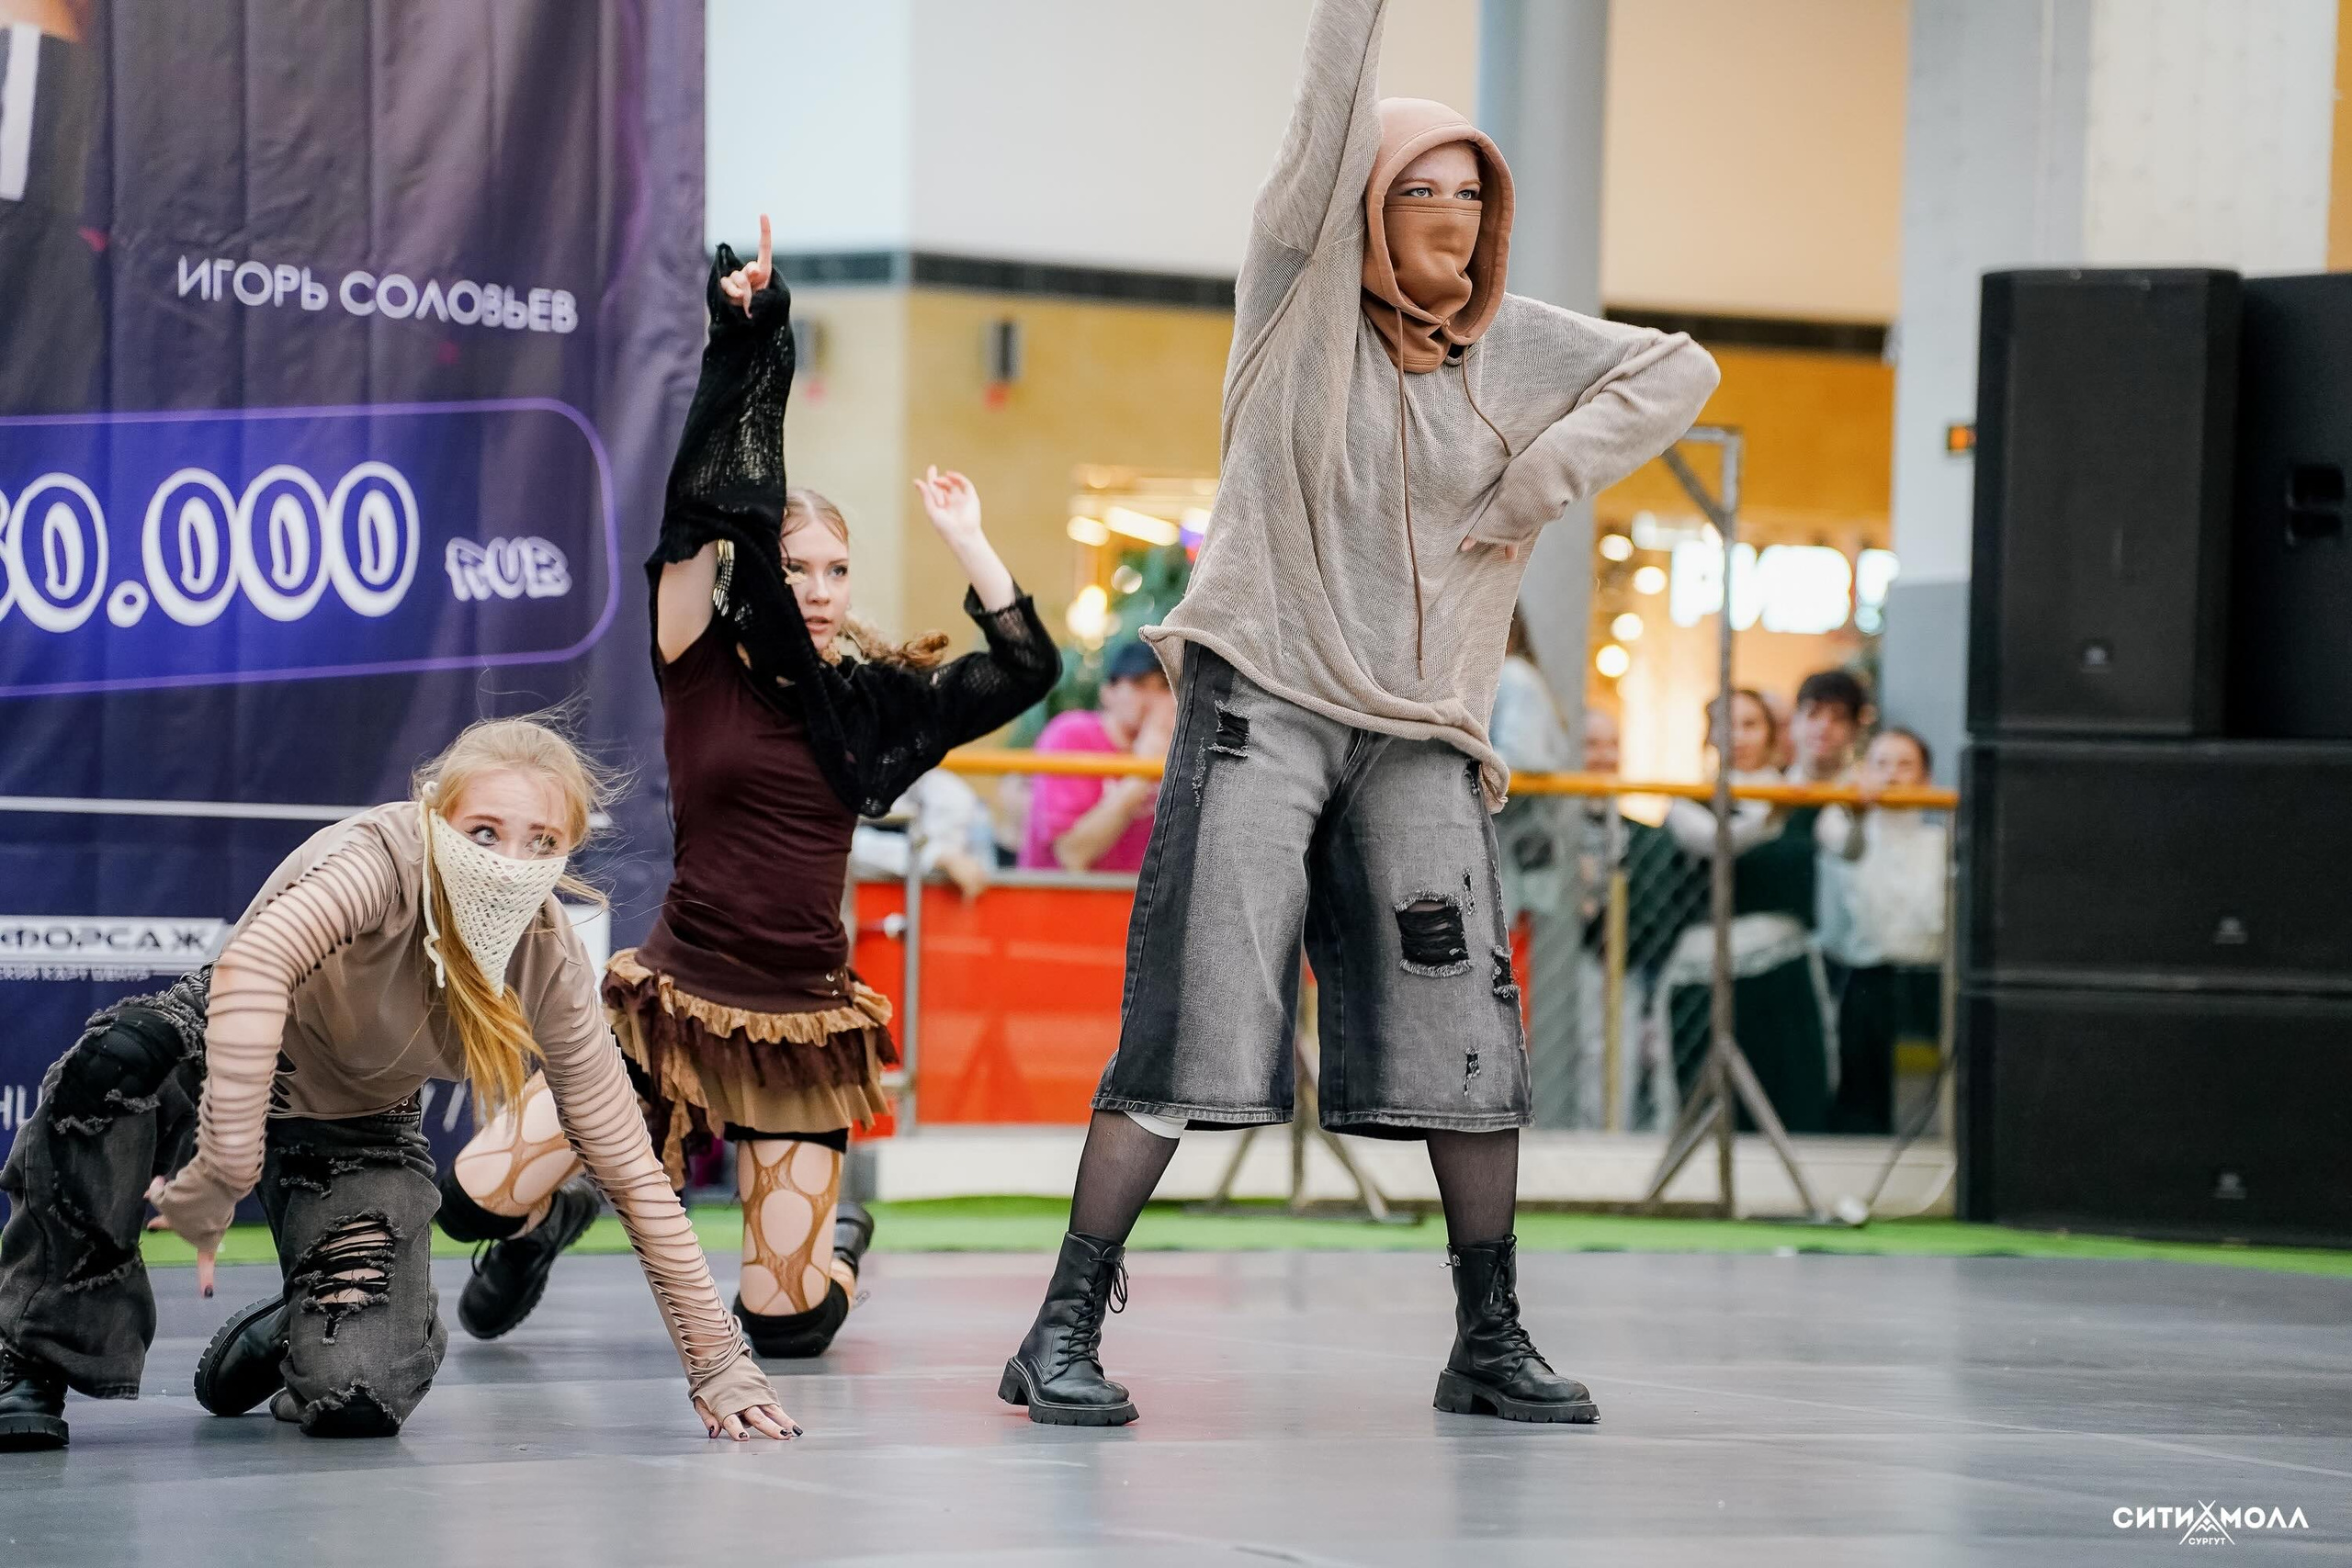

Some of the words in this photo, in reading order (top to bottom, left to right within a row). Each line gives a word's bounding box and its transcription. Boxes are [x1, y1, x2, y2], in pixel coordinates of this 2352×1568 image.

[177, 254, 329, 311] ИГОРЬ
[339, 270, 579, 333] СОЛОВЬЕВ
[0, 461, 421, 634] 0.000
[445, 536, 572, 601] RUB
[0, 926, 208, 956] ФОРСАЖ
